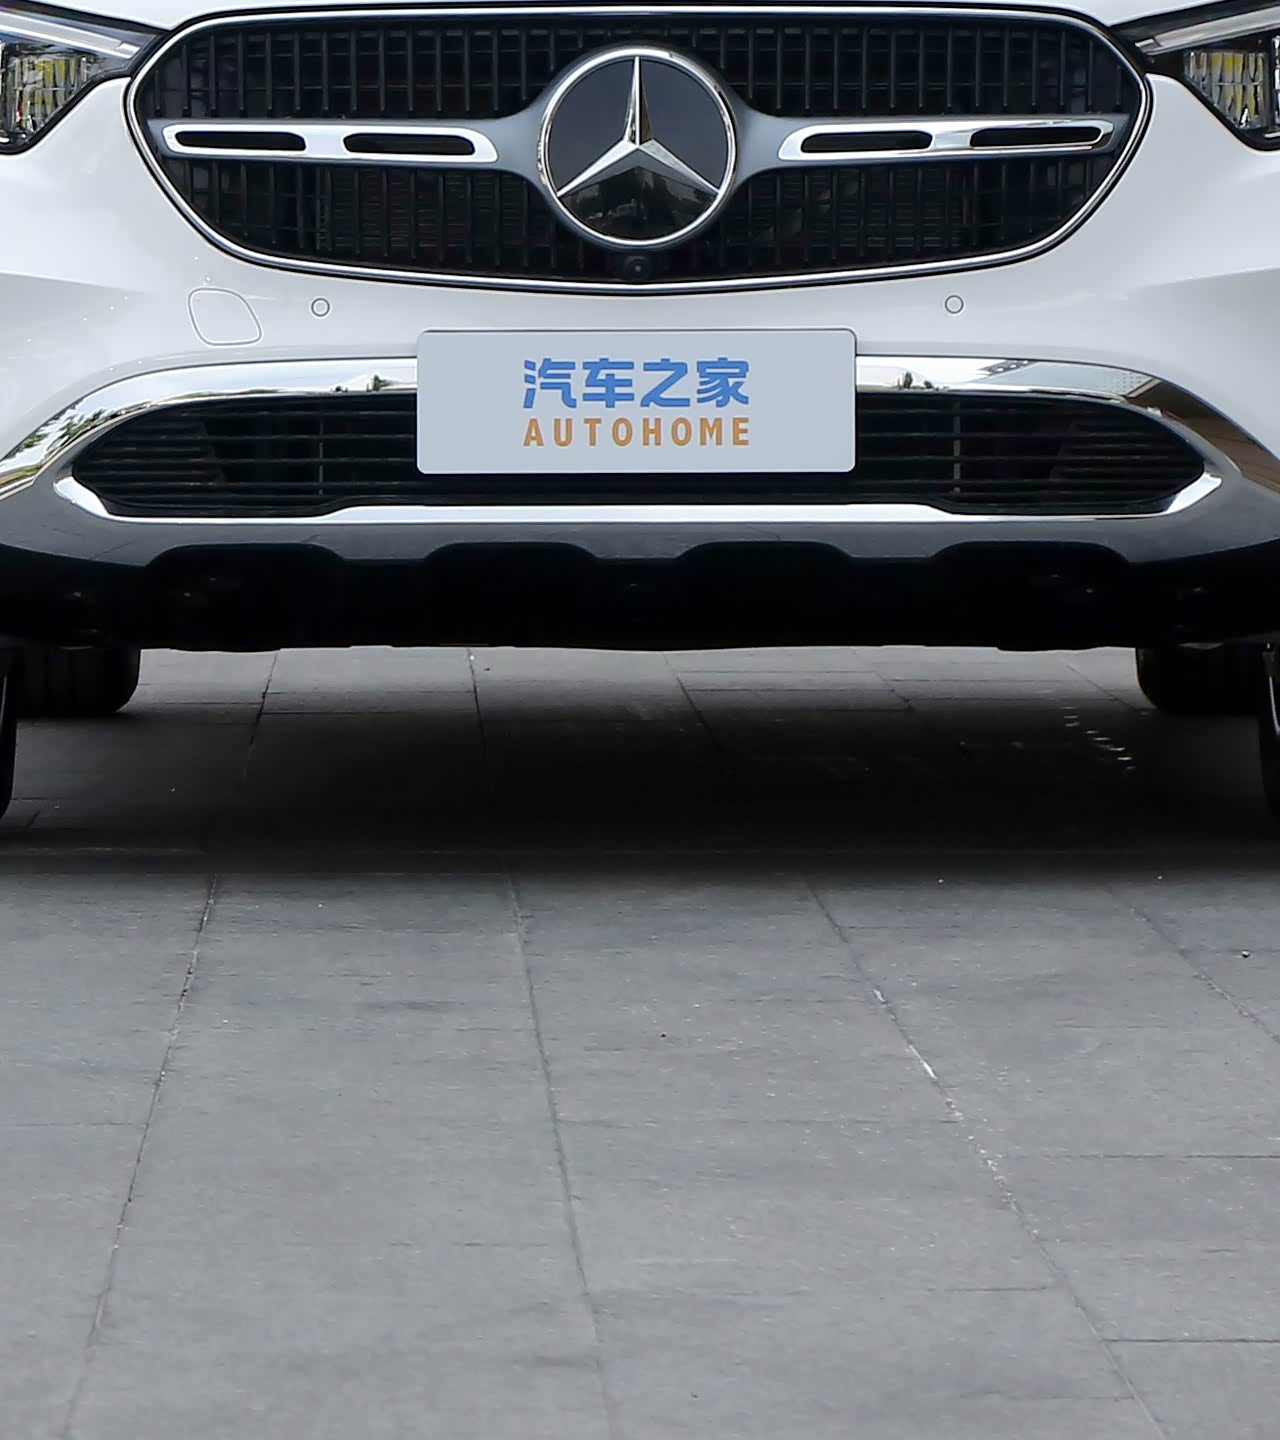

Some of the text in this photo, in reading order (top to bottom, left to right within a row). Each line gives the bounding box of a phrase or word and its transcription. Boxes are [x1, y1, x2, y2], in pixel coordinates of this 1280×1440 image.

[523, 357, 750, 409] 汽车之家
[523, 417, 749, 448] AUTOHOME
